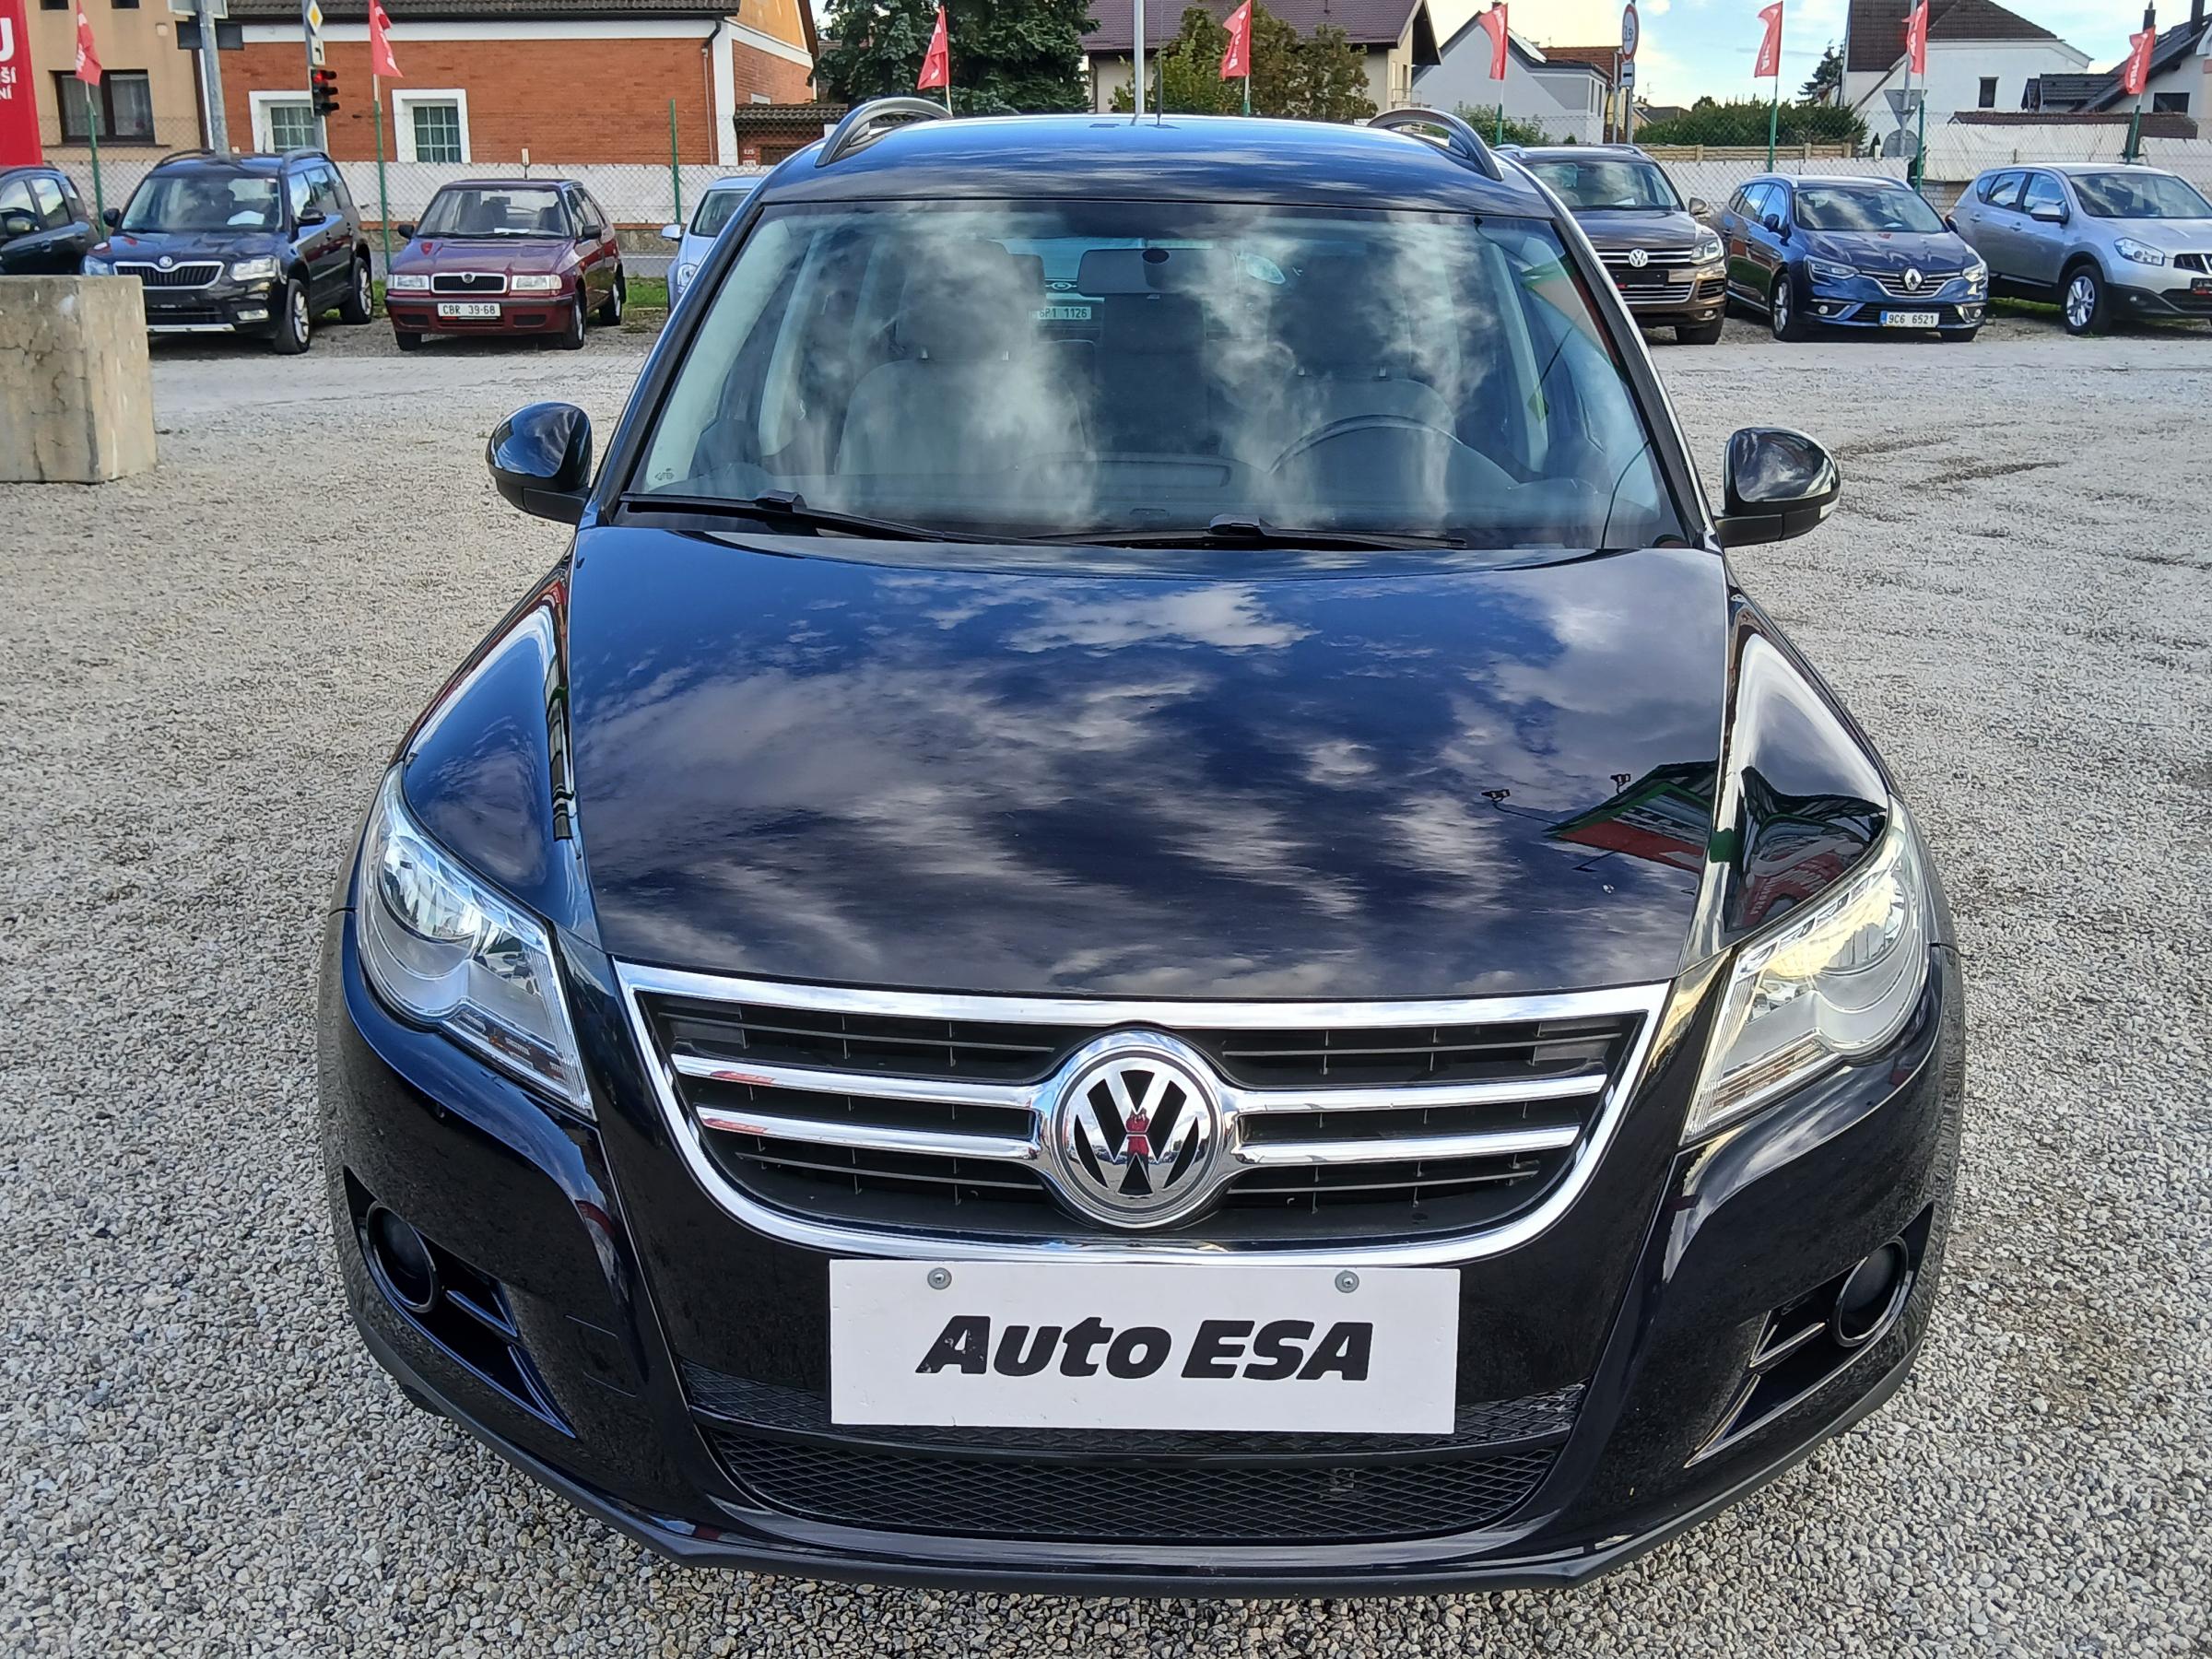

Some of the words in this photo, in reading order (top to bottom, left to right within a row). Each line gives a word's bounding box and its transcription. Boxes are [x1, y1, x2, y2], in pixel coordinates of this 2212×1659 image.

[442, 304, 462, 315] CBR
[467, 304, 496, 315] 39-68
[1064, 308, 1088, 319] 1126
[1888, 314, 1906, 324] 9C6
[1912, 314, 1935, 324] 6521
[914, 1314, 1172, 1379] Auto
[1181, 1319, 1373, 1382] ESA
